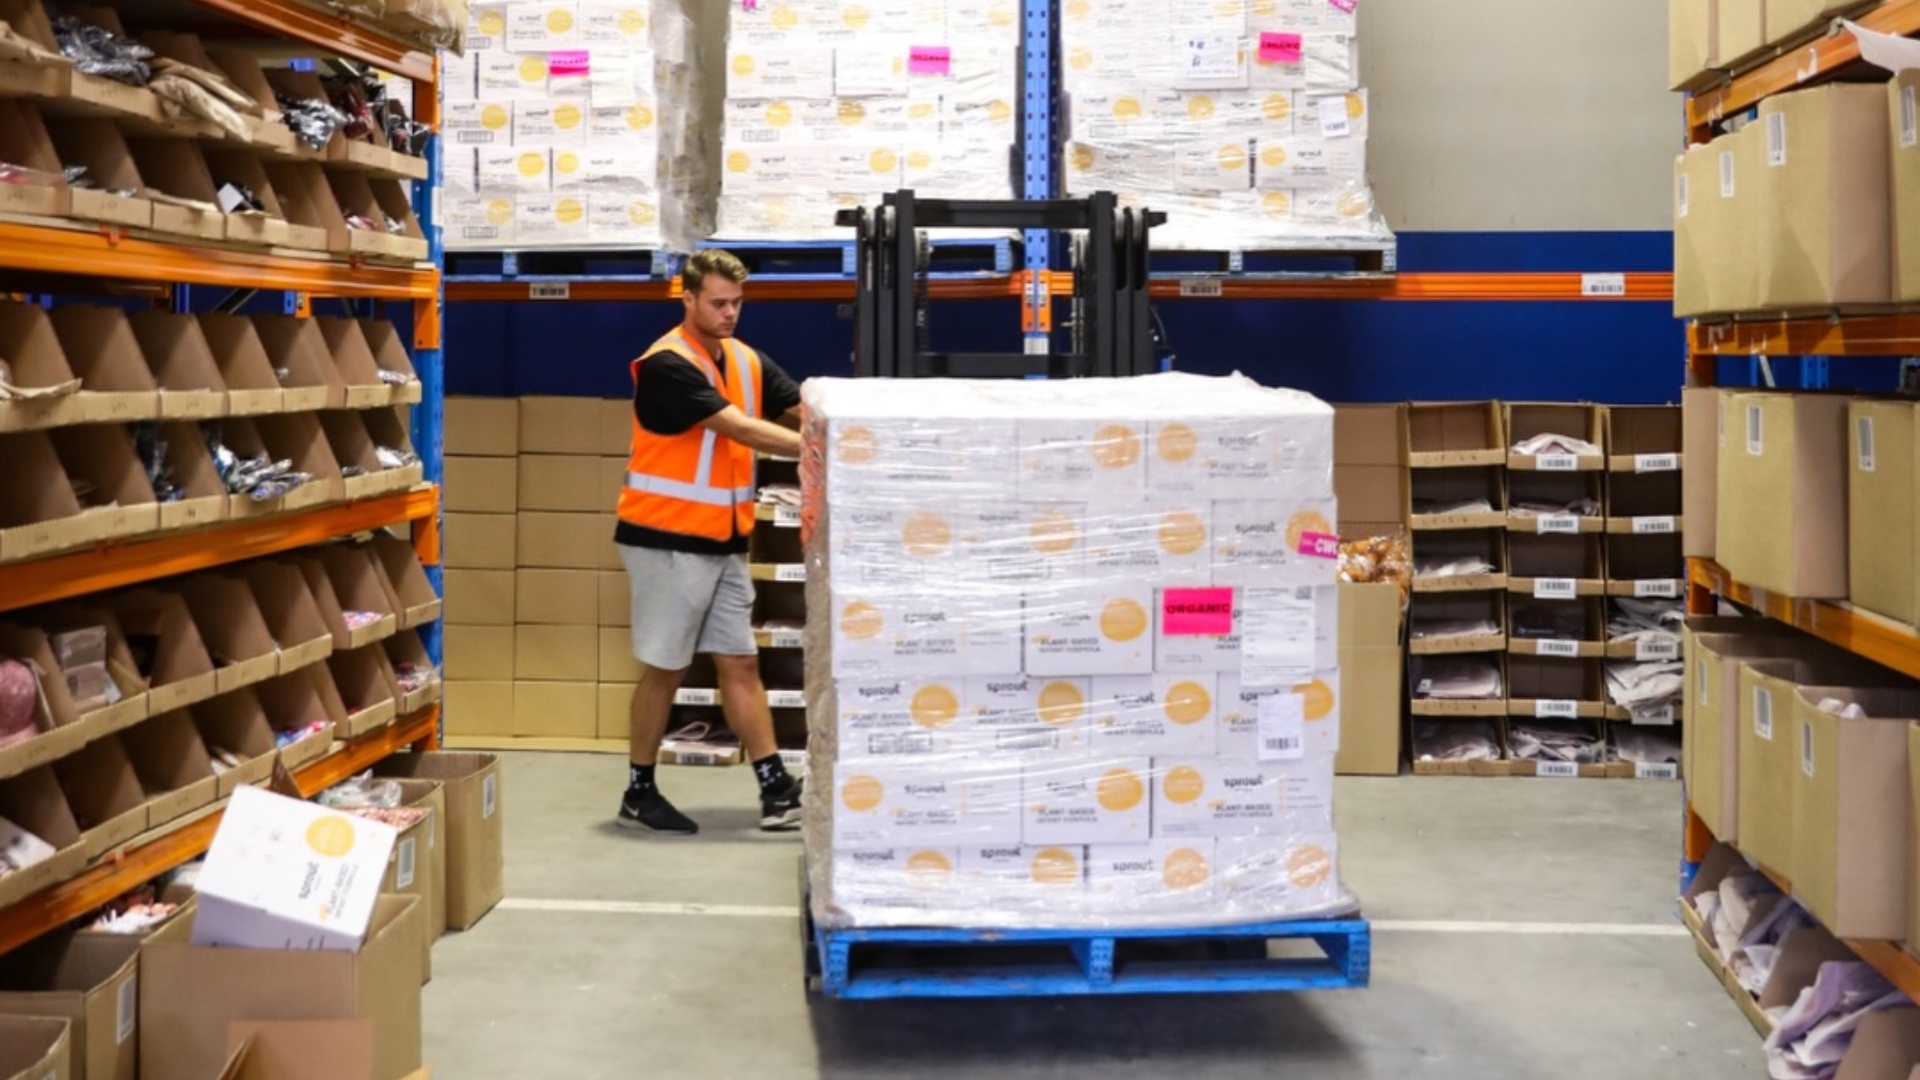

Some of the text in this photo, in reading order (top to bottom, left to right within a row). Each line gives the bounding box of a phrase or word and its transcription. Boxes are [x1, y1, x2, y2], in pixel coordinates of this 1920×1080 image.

[1166, 603, 1231, 615] ORGANIC
[858, 683, 900, 697] sprout
[987, 680, 1028, 694] sprout
[1223, 774, 1264, 788] sprout
[980, 847, 1021, 860] sprout
[1112, 859, 1154, 873] sprout
